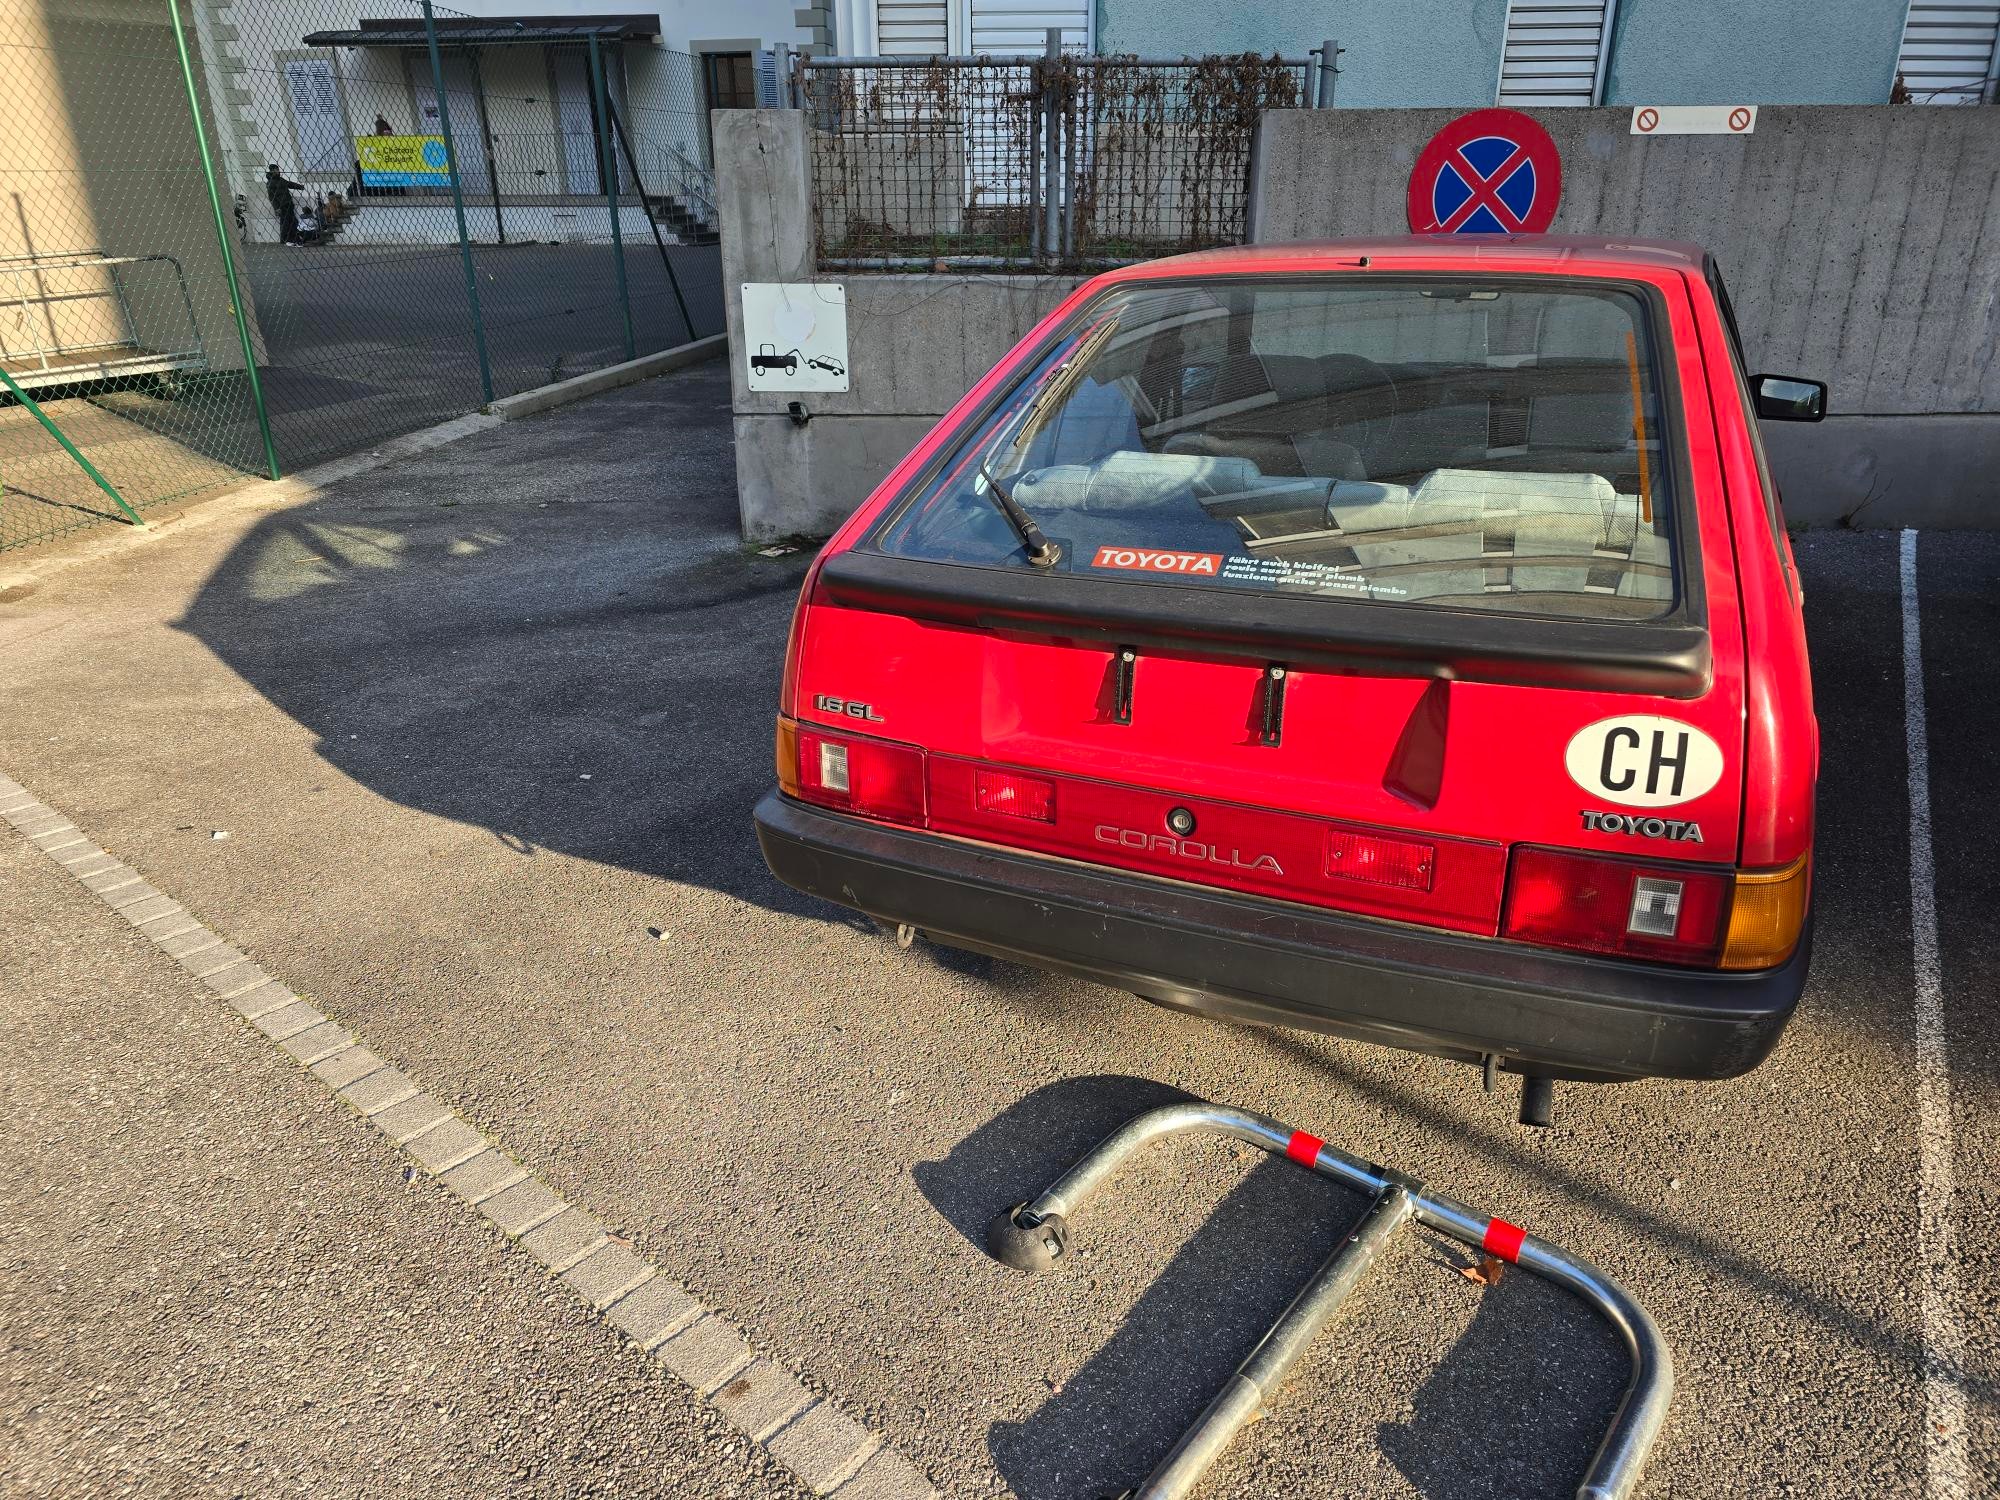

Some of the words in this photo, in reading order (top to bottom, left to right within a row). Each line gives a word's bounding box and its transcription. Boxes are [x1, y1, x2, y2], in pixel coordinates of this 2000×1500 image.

[1101, 549, 1213, 573] TOYOTA
[1228, 556, 1259, 565] fährt
[1261, 560, 1290, 568] auch
[1293, 561, 1340, 572] bleifrei
[1222, 571, 1276, 582] funziona
[1278, 577, 1316, 586] anche
[1319, 581, 1356, 590] senza
[1359, 584, 1407, 595] piombo
[1260, 567, 1292, 575] aussi
[1325, 573, 1365, 582] plomb
[817, 695, 843, 714] 1.6
[846, 701, 885, 723] GL
[1600, 726, 1689, 796] CH
[1581, 810, 1704, 843] TOYOTA
[1094, 824, 1284, 876] COROLLA
